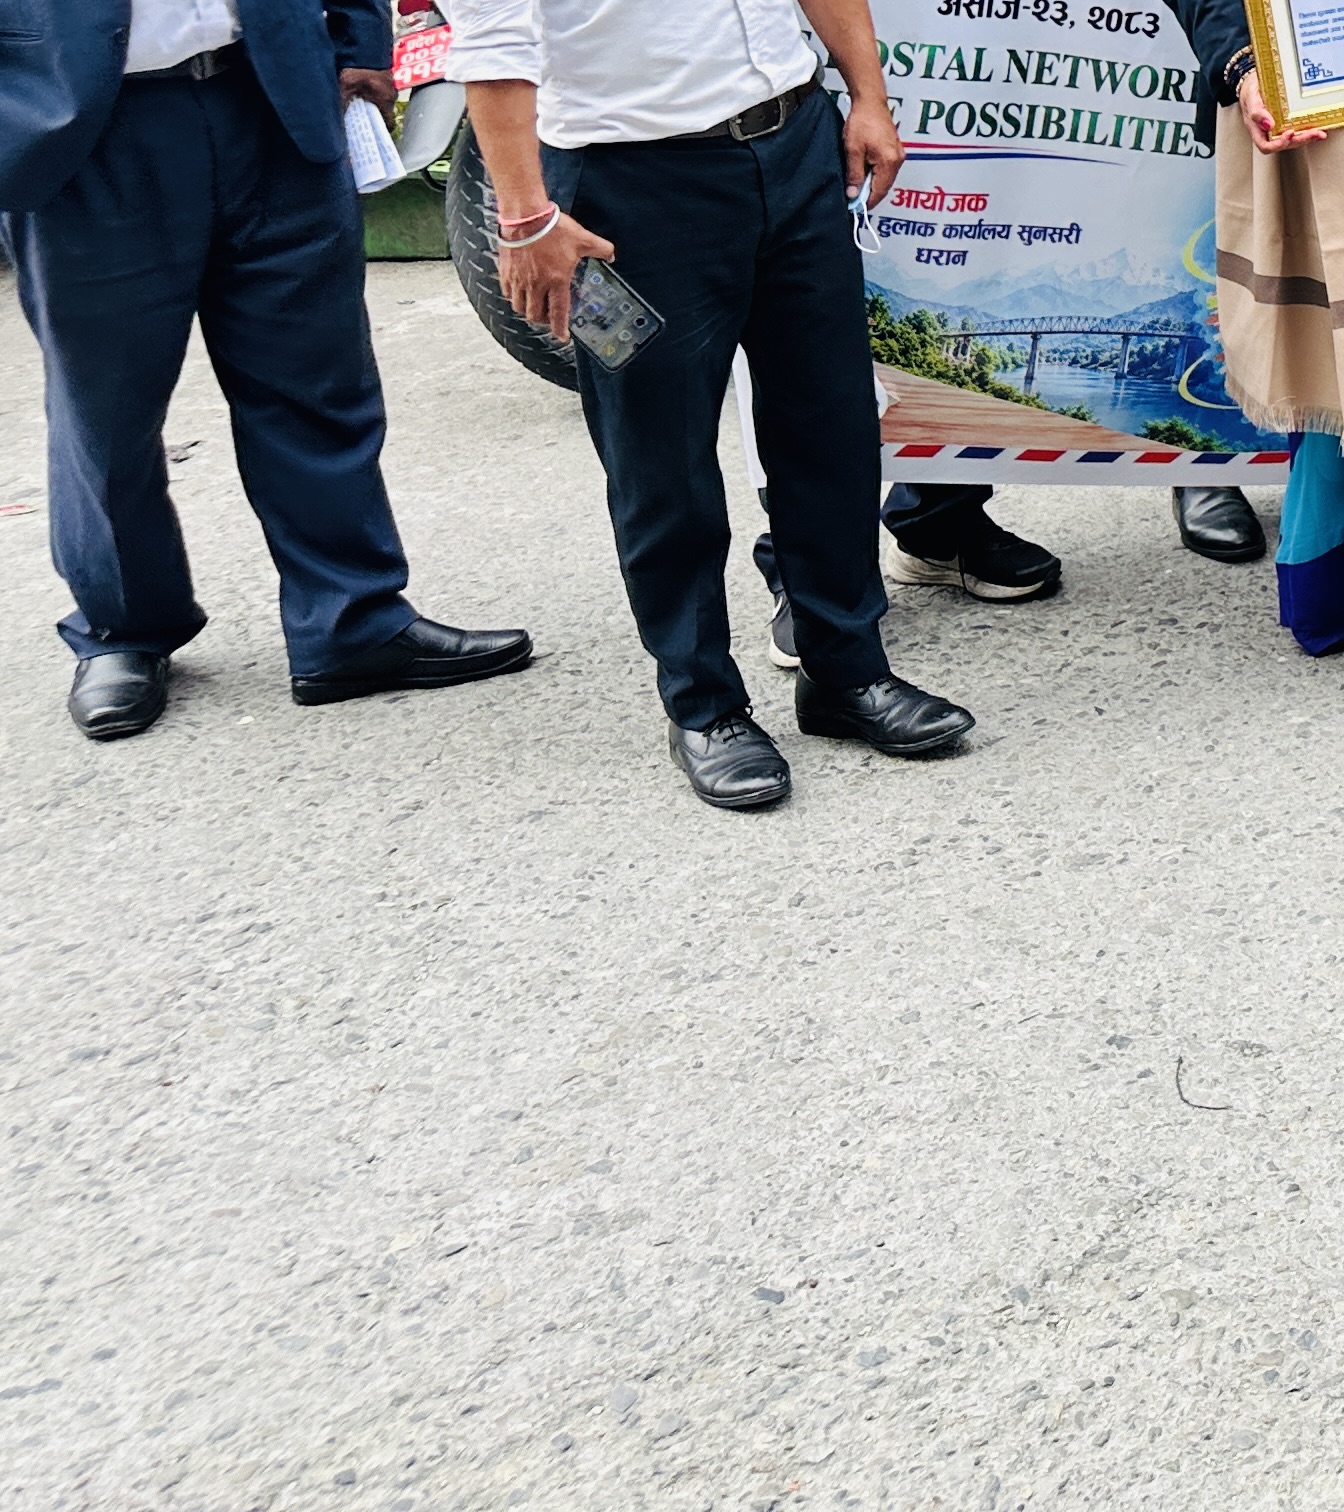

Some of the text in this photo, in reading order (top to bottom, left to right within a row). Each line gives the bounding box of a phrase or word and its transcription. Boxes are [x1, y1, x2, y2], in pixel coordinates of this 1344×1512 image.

[1087, 5, 1161, 37] २०८३
[890, 186, 989, 213] आयोजक
[878, 212, 935, 238] हुलाक
[942, 217, 1010, 241] कार्यालय
[1018, 222, 1083, 246] सुनसरी
[915, 247, 968, 267] धरान
